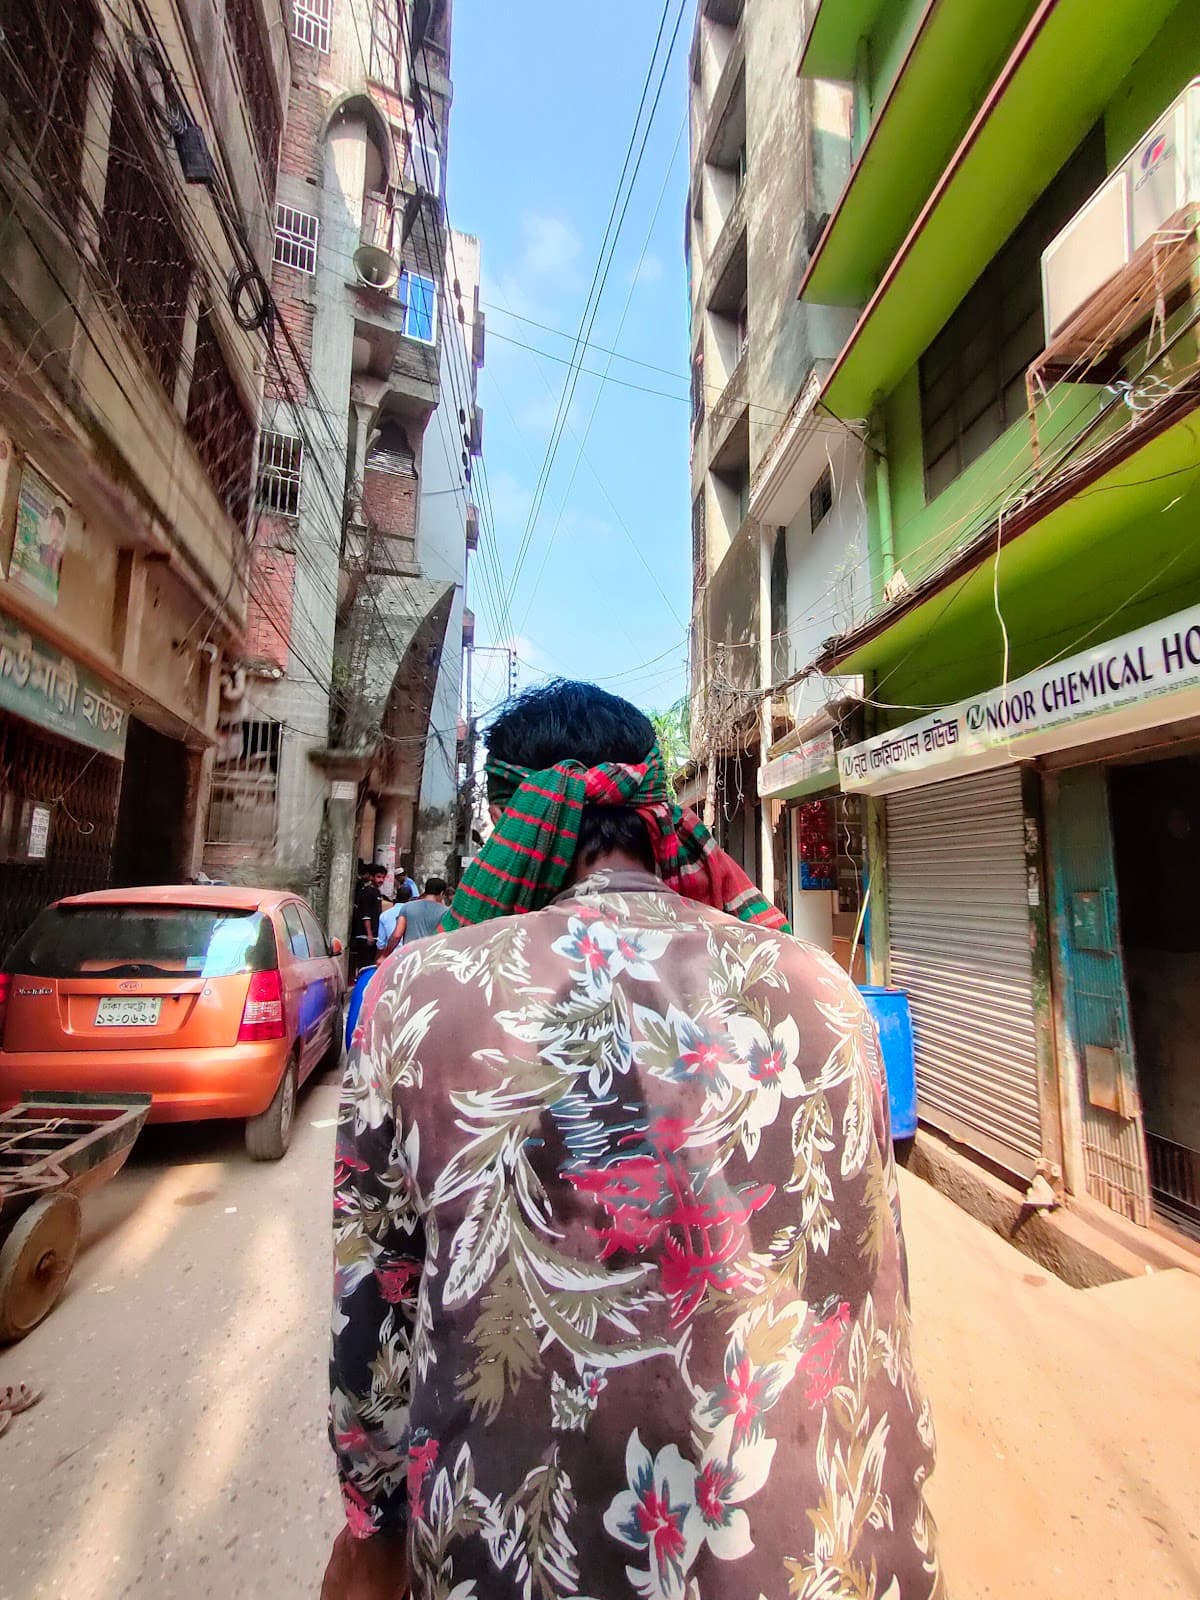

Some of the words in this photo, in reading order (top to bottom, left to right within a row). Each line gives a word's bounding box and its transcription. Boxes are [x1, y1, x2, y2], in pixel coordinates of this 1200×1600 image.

[985, 690, 1036, 731] NOOR
[1041, 646, 1153, 713] CHEMICAL
[922, 719, 959, 752] হাউজ
